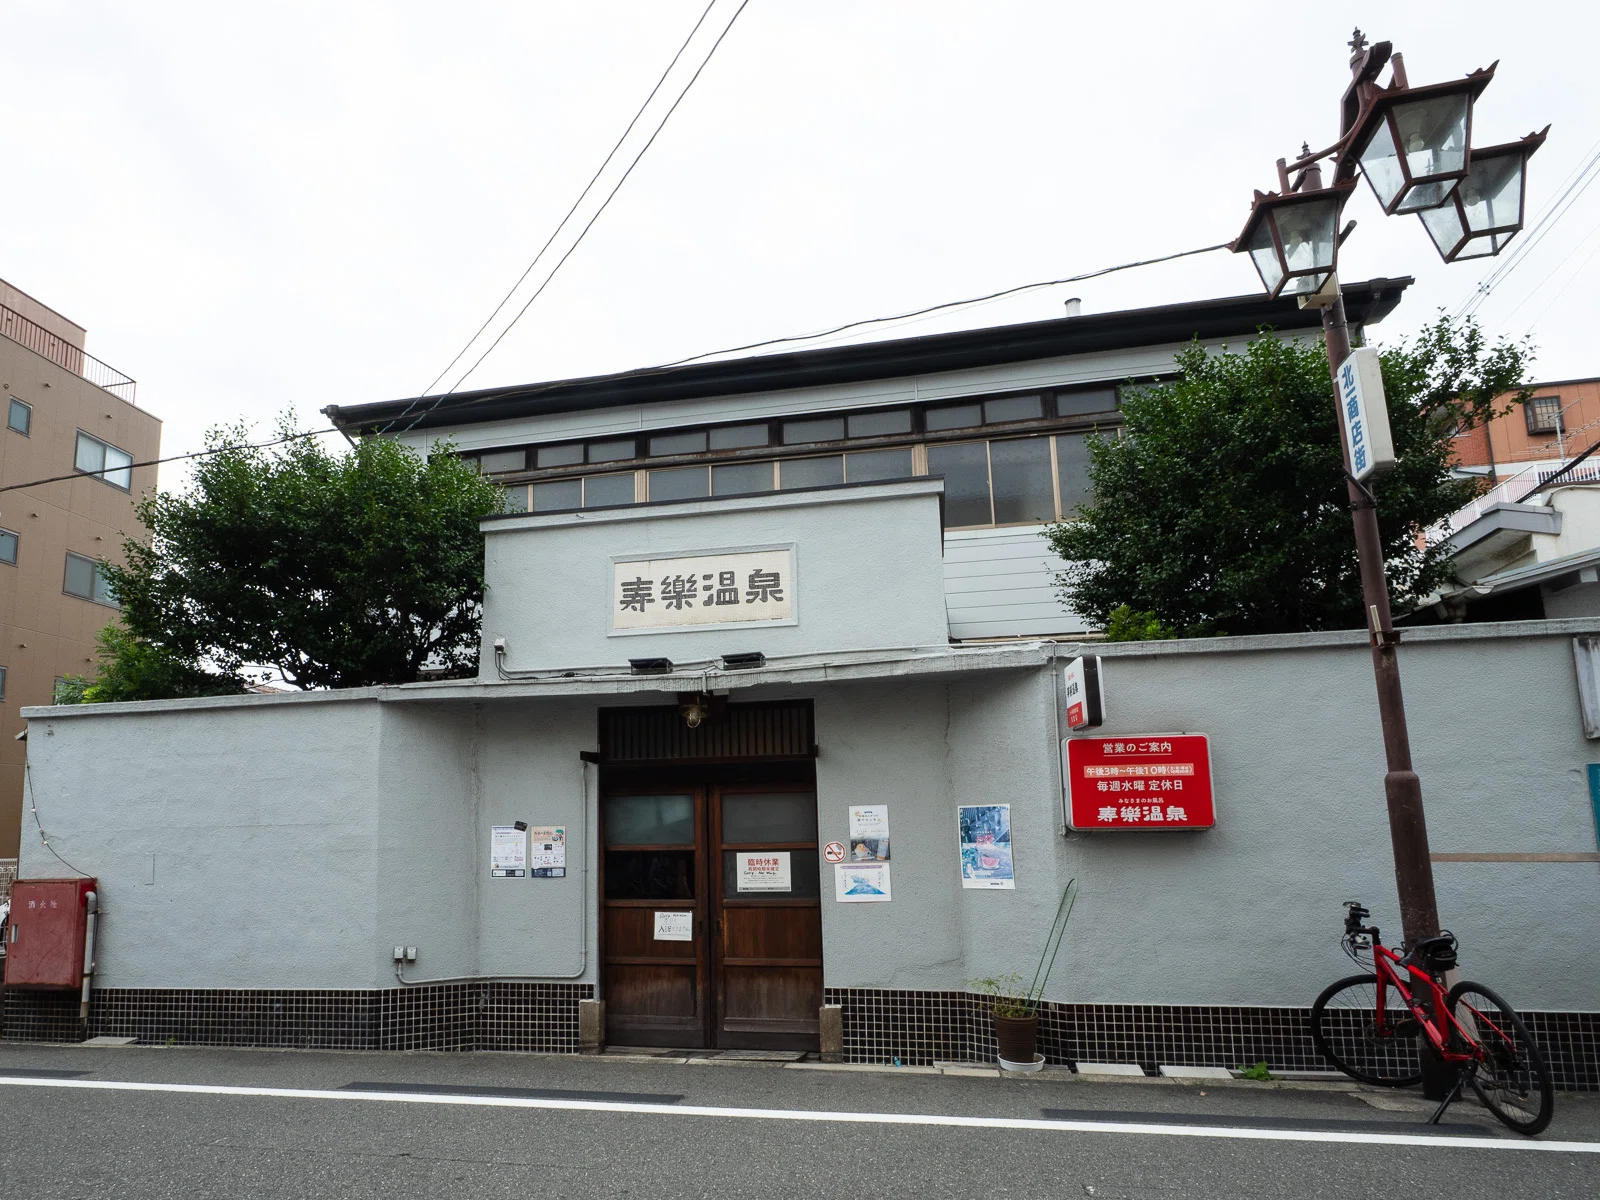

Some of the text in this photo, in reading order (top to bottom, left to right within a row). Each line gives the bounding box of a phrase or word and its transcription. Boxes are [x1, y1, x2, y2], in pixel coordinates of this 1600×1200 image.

[1341, 364, 1367, 474] 北一商店街
[619, 568, 784, 613] 寿樂温泉
[1102, 742, 1172, 754] 営業のご案内
[1096, 779, 1183, 792] 毎週水曜 定休日
[747, 858, 780, 867] 臨時休業
